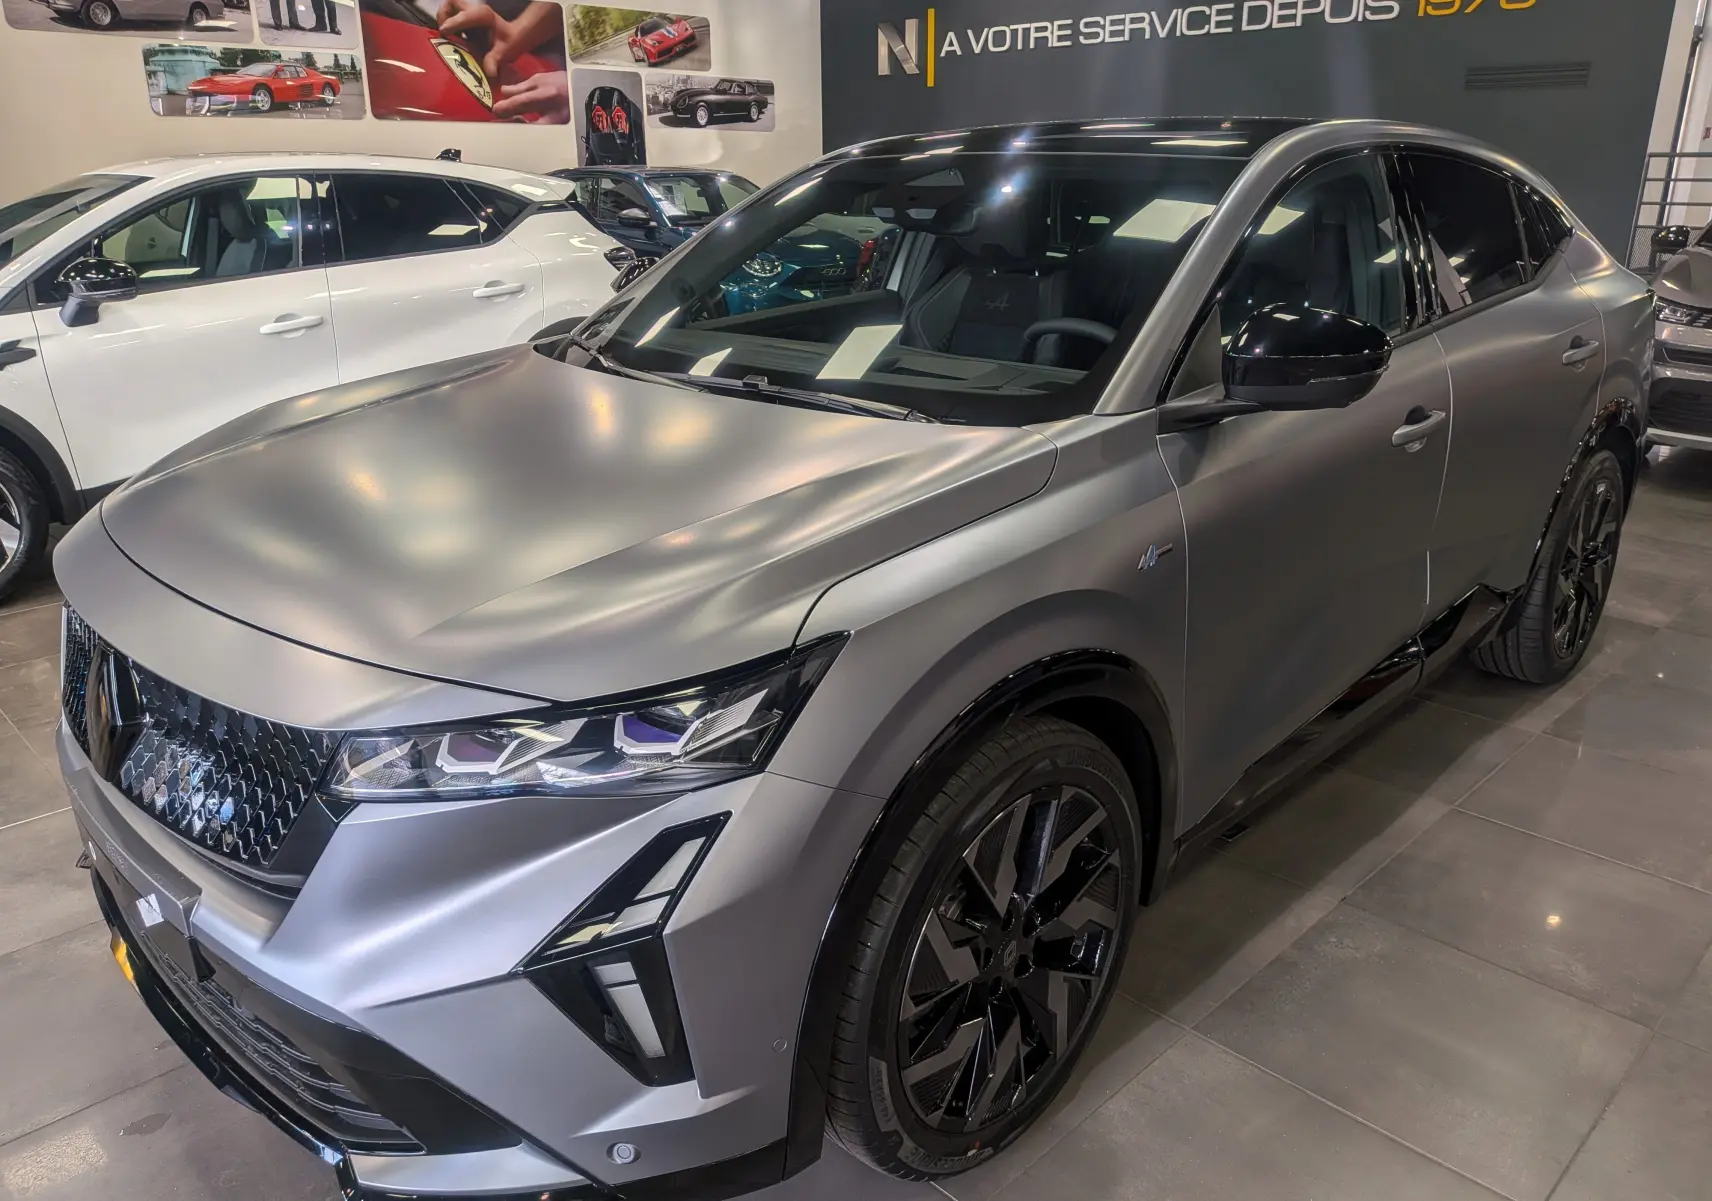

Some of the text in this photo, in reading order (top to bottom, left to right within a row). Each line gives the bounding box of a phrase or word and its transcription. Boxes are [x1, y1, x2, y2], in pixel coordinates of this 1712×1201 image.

[877, 18, 920, 76] N
[940, 0, 1537, 57] A VOTRE SERVICE DEPUIS 19
